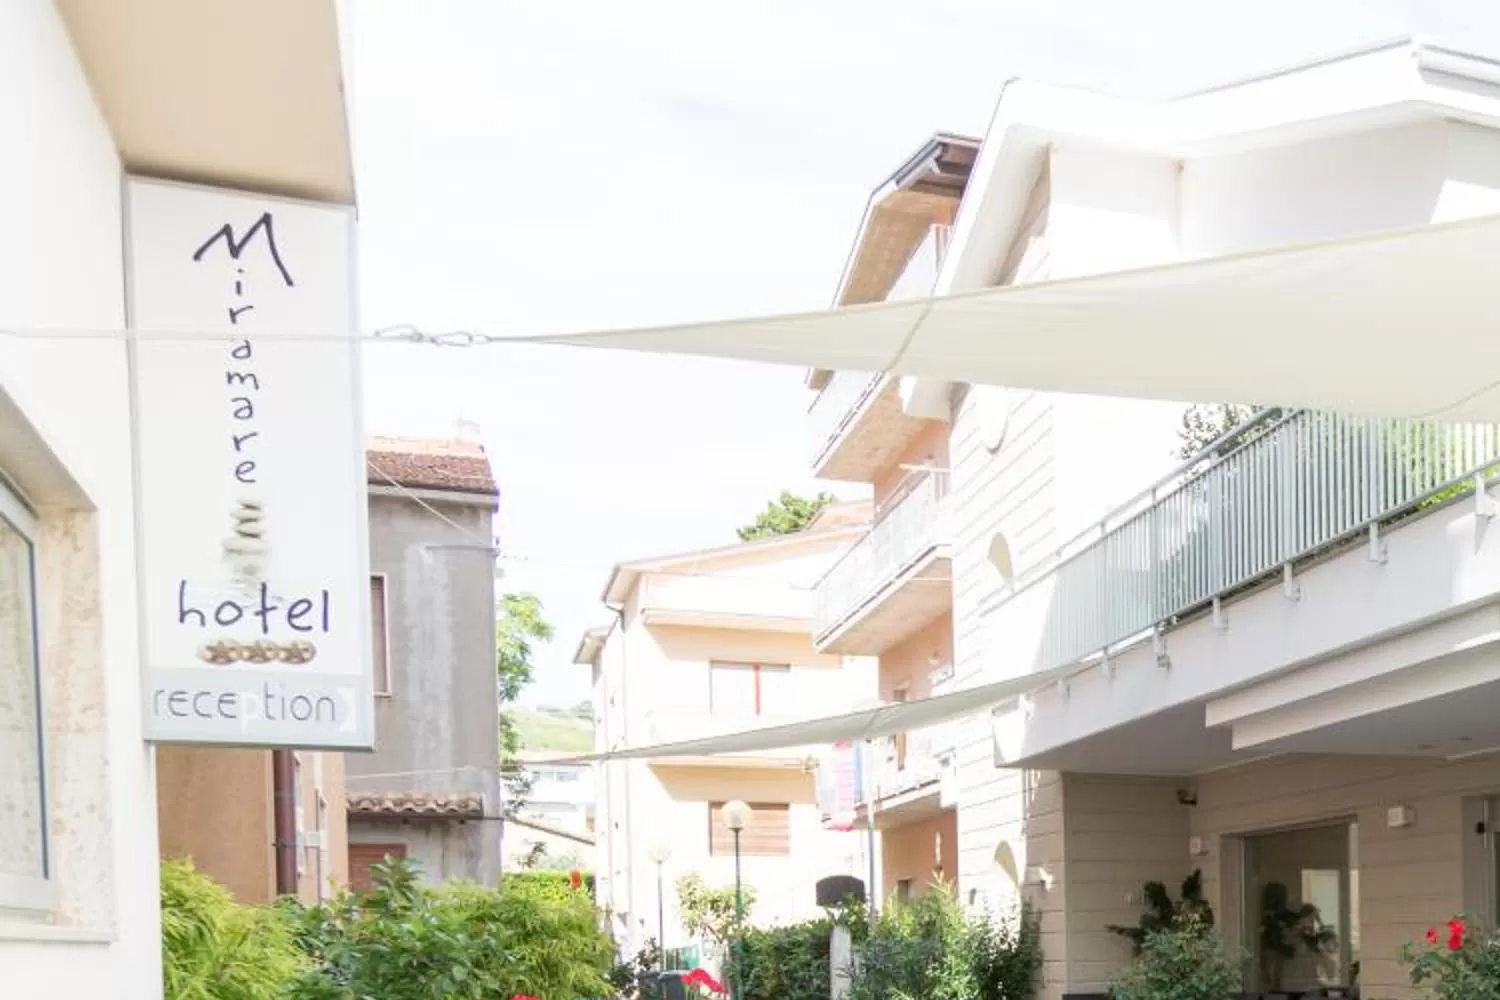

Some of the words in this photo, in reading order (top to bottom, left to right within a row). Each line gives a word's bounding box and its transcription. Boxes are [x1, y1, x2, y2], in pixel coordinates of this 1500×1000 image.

[192, 211, 294, 483] Miramare
[178, 579, 329, 634] hotel
[152, 680, 337, 735] reception
